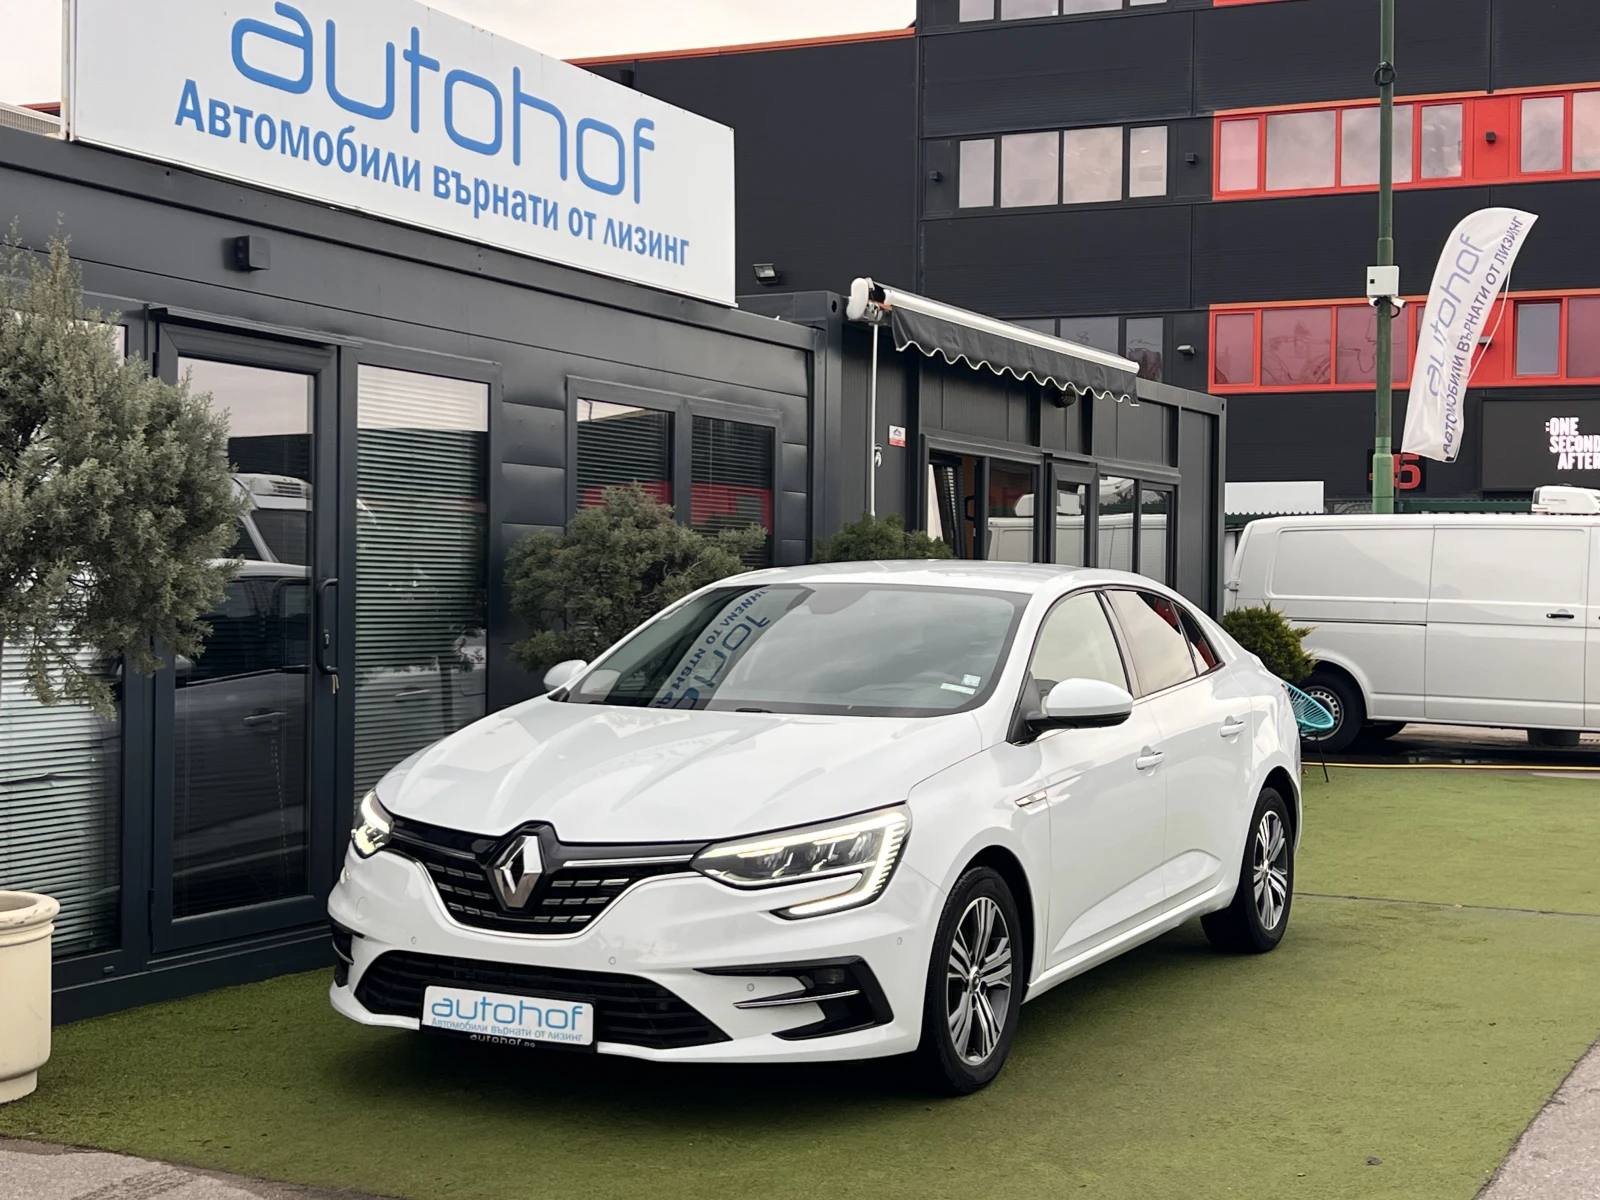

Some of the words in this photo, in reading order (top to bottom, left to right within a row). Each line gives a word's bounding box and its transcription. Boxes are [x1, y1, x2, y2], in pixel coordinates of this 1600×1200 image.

[230, 2, 655, 204] autohof
[175, 79, 421, 192] Автомобили
[433, 165, 559, 231] върнати
[568, 207, 597, 240] от
[604, 218, 690, 265] лизинг
[1443, 354, 1466, 454] АВТОМОБИЛИ
[1457, 286, 1491, 353] ВЪРНАТИ
[1485, 263, 1501, 285] ОТ
[1494, 216, 1524, 265] ЛИЗИНГ
[1549, 435, 1600, 453] SECOND
[431, 996, 583, 1031] autohof
[431, 1017, 488, 1032] Автомобили
[491, 1026, 531, 1037] върнати
[534, 1030, 546, 1038] от
[549, 1032, 583, 1042] лизинг
